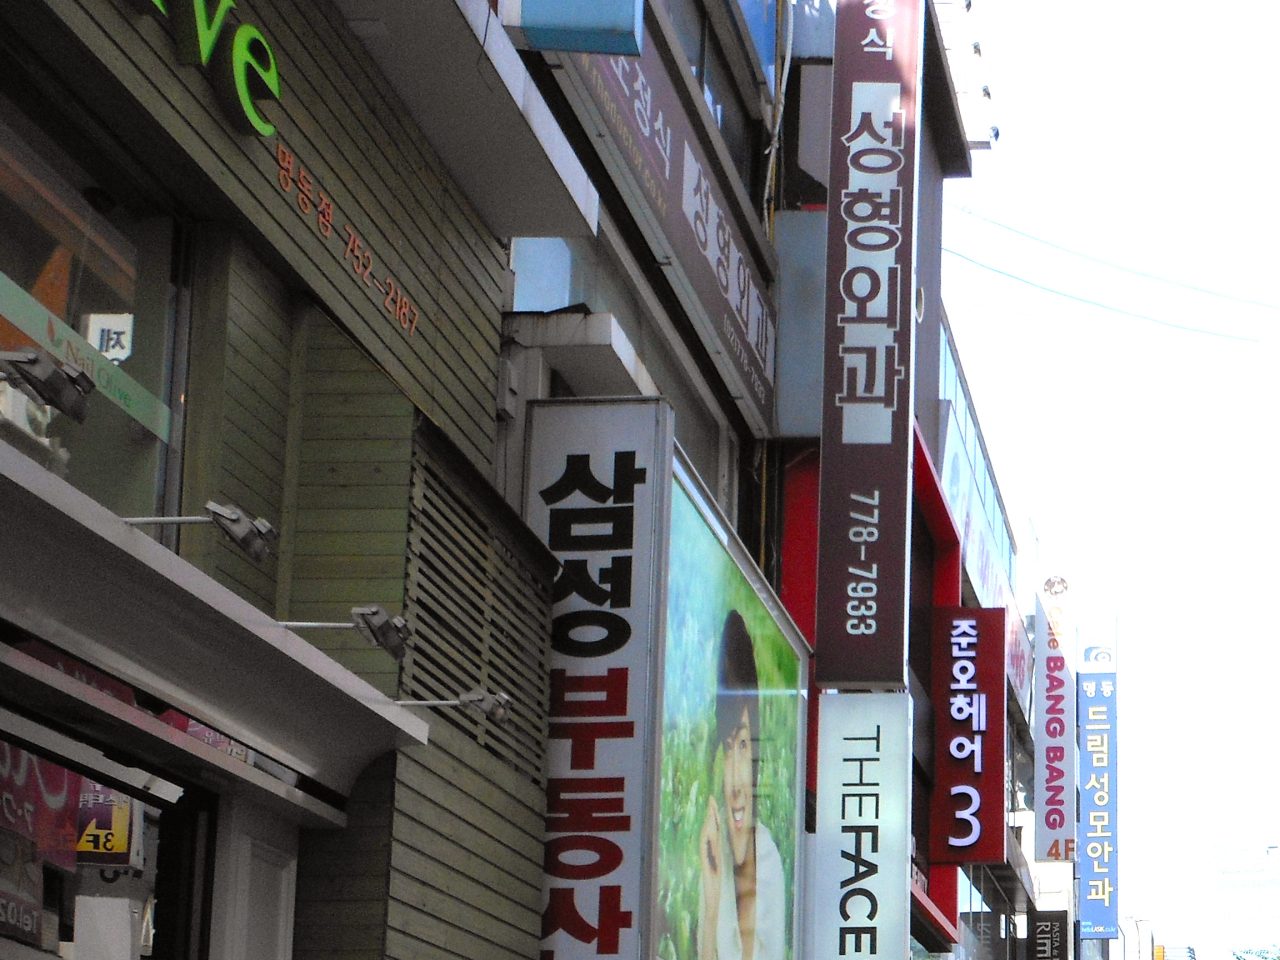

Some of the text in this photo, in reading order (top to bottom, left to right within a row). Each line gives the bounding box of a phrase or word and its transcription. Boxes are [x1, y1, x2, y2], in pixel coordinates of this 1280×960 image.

[277, 144, 420, 337] 명동점 752-2187
[837, 108, 905, 411] 성형외과
[846, 489, 880, 636] 778-7933
[950, 619, 987, 773] 준오헤어
[1045, 655, 1065, 739] BANG
[1045, 747, 1066, 831] BANG
[1085, 706, 1113, 906] 드림성모안과
